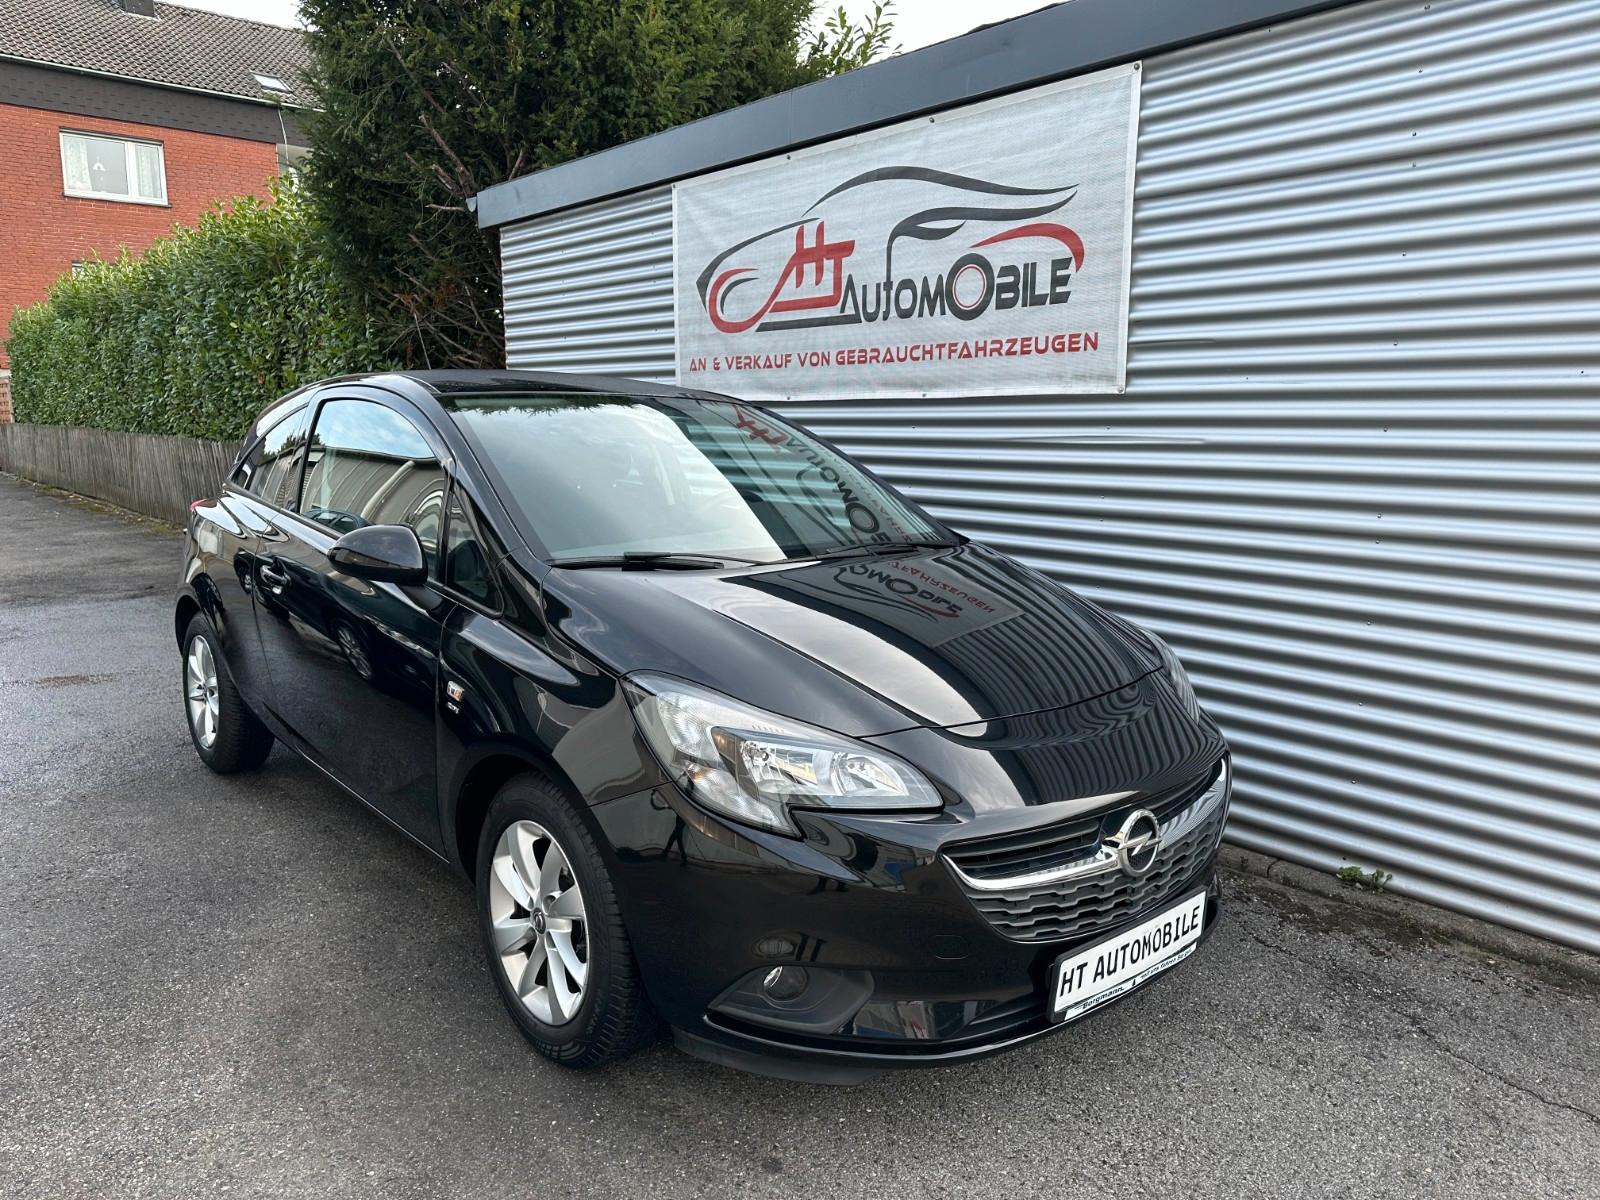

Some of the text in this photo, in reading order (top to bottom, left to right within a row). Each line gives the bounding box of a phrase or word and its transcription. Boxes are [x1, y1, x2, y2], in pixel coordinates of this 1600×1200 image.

[839, 253, 1073, 323] AUTOMOBILE
[689, 332, 1099, 372] AN & VERKAUF VON GEBRAUCHTFAHRZEUGEN
[1059, 905, 1200, 997] HT AUTOMOBILE
